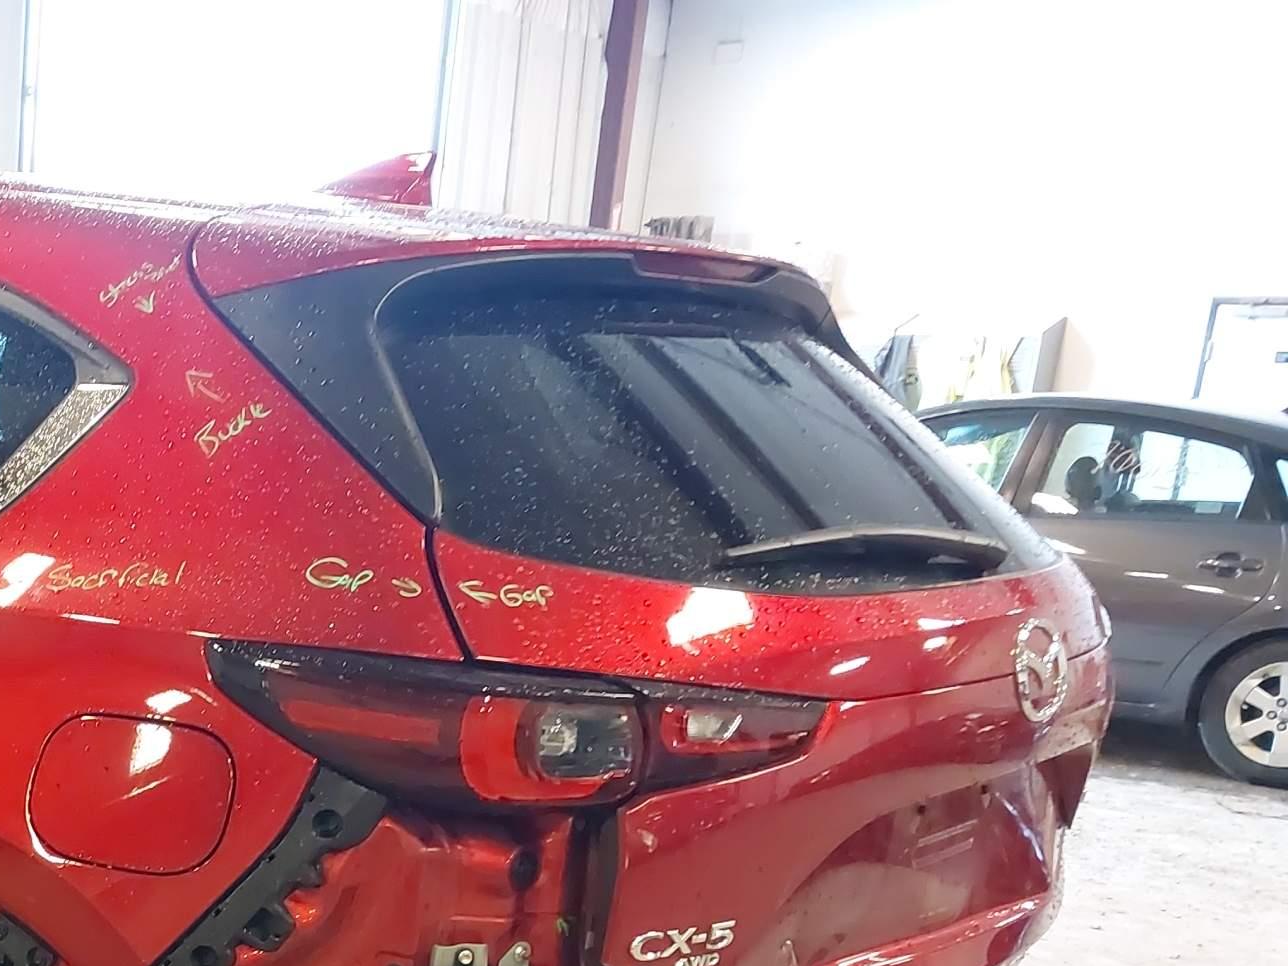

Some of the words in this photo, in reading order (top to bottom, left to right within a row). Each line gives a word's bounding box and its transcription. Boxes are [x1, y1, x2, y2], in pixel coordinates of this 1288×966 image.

[305, 556, 374, 593] Gap
[500, 583, 554, 607] Gap
[630, 919, 736, 961] CX-5
